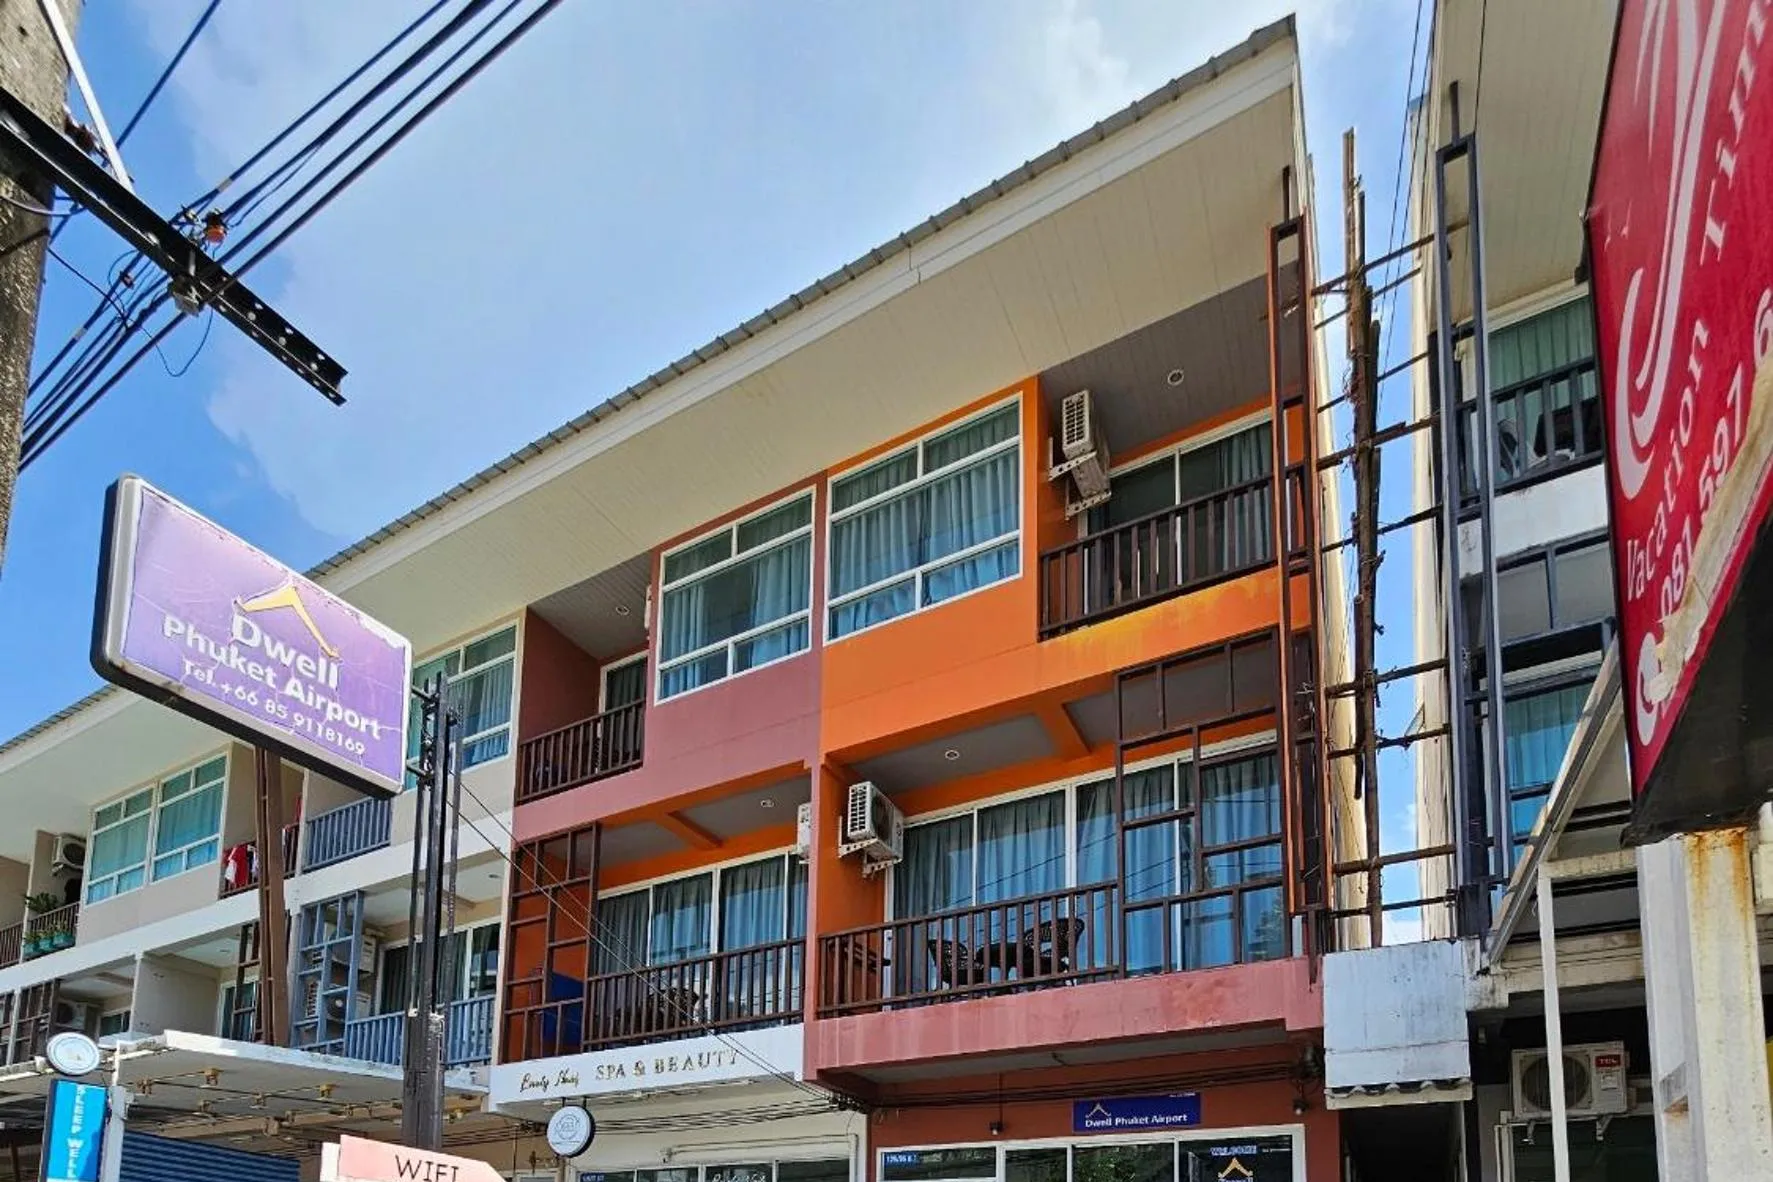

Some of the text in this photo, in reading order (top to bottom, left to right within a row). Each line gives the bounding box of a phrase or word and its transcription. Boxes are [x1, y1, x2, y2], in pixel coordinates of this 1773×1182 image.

[1627, 0, 1773, 602] Vacation Tim
[1660, 516, 1693, 620] 081
[163, 615, 382, 740] Phuket Airport
[233, 613, 340, 690] Dwell
[265, 699, 289, 719] 85
[293, 715, 366, 756] 9118169
[595, 1063, 626, 1081] SPA
[654, 1049, 738, 1074] BEAUTY
[66, 1083, 86, 1180] SLEEP WELL
[1085, 1114, 1188, 1128] Dwell Phuket Airport
